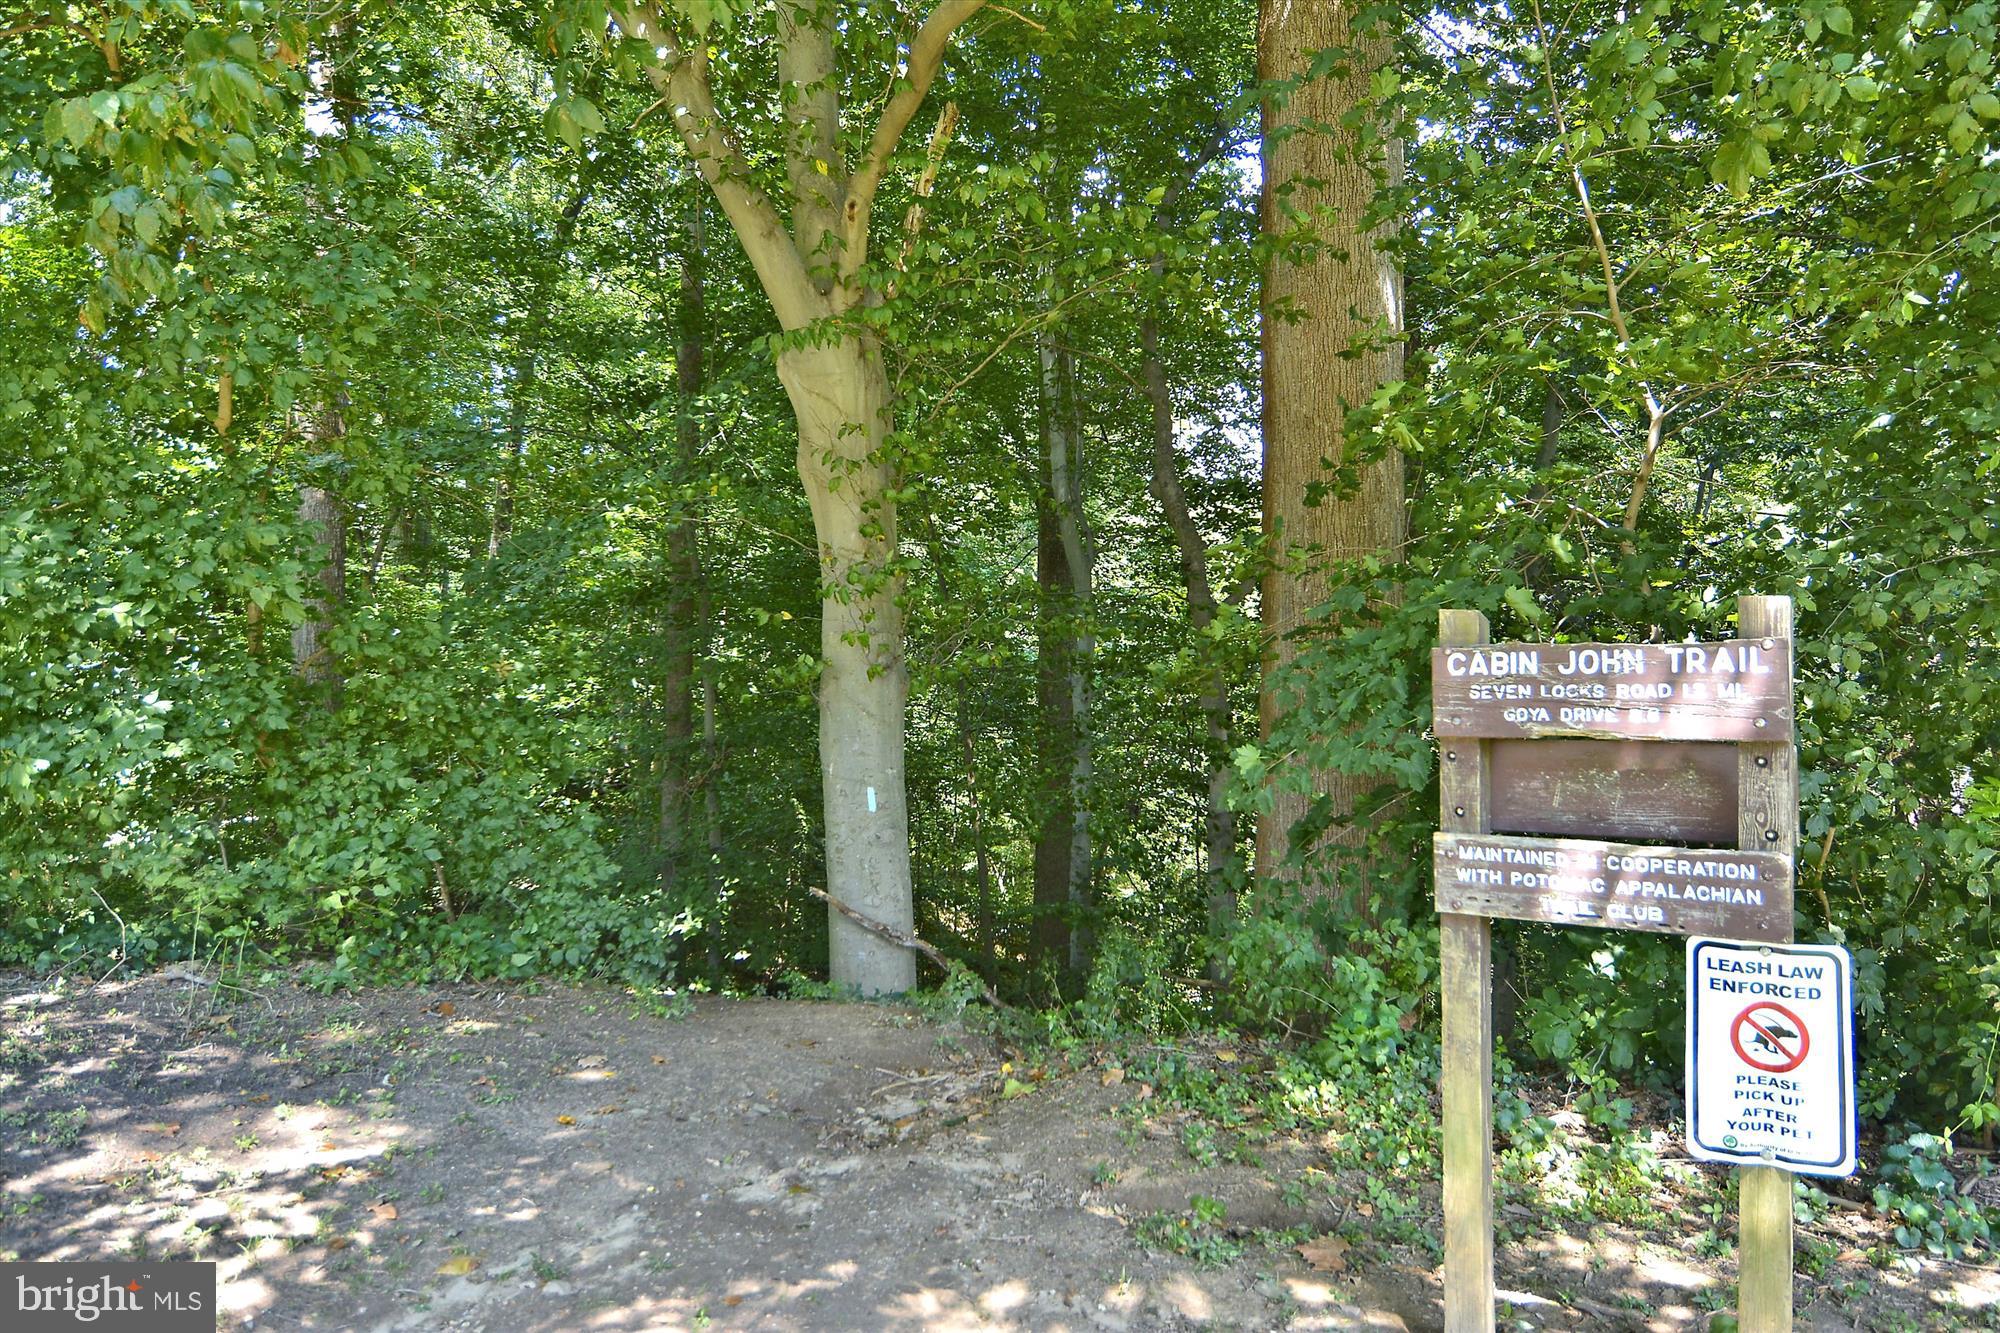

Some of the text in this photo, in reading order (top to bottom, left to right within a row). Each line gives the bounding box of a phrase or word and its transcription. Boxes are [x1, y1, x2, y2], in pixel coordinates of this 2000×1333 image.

[1447, 646, 1770, 676] CABIN JOHN TRAIL
[1469, 684, 1532, 700] SEVEN
[1540, 683, 1606, 699] LOCKS
[1615, 683, 1673, 699] ROAD
[1503, 707, 1550, 722] GOYA
[1560, 707, 1620, 723] DRIVE
[1458, 845, 1569, 867] MAINTAINED
[1606, 855, 1756, 881] COOPERATION
[1456, 868, 1763, 906] WITH POTOAC APPALACHIAN
[1606, 903, 1664, 922] CLUB
[1706, 957, 1823, 980] LEASH LAW
[1709, 977, 1822, 1000] ENFORCED
[1736, 1075, 1801, 1091] PLEASE
[1734, 1090, 1775, 1102] PICK
[1742, 1107, 1797, 1123] AFTER
[1727, 1119, 1775, 1133] YOUR
